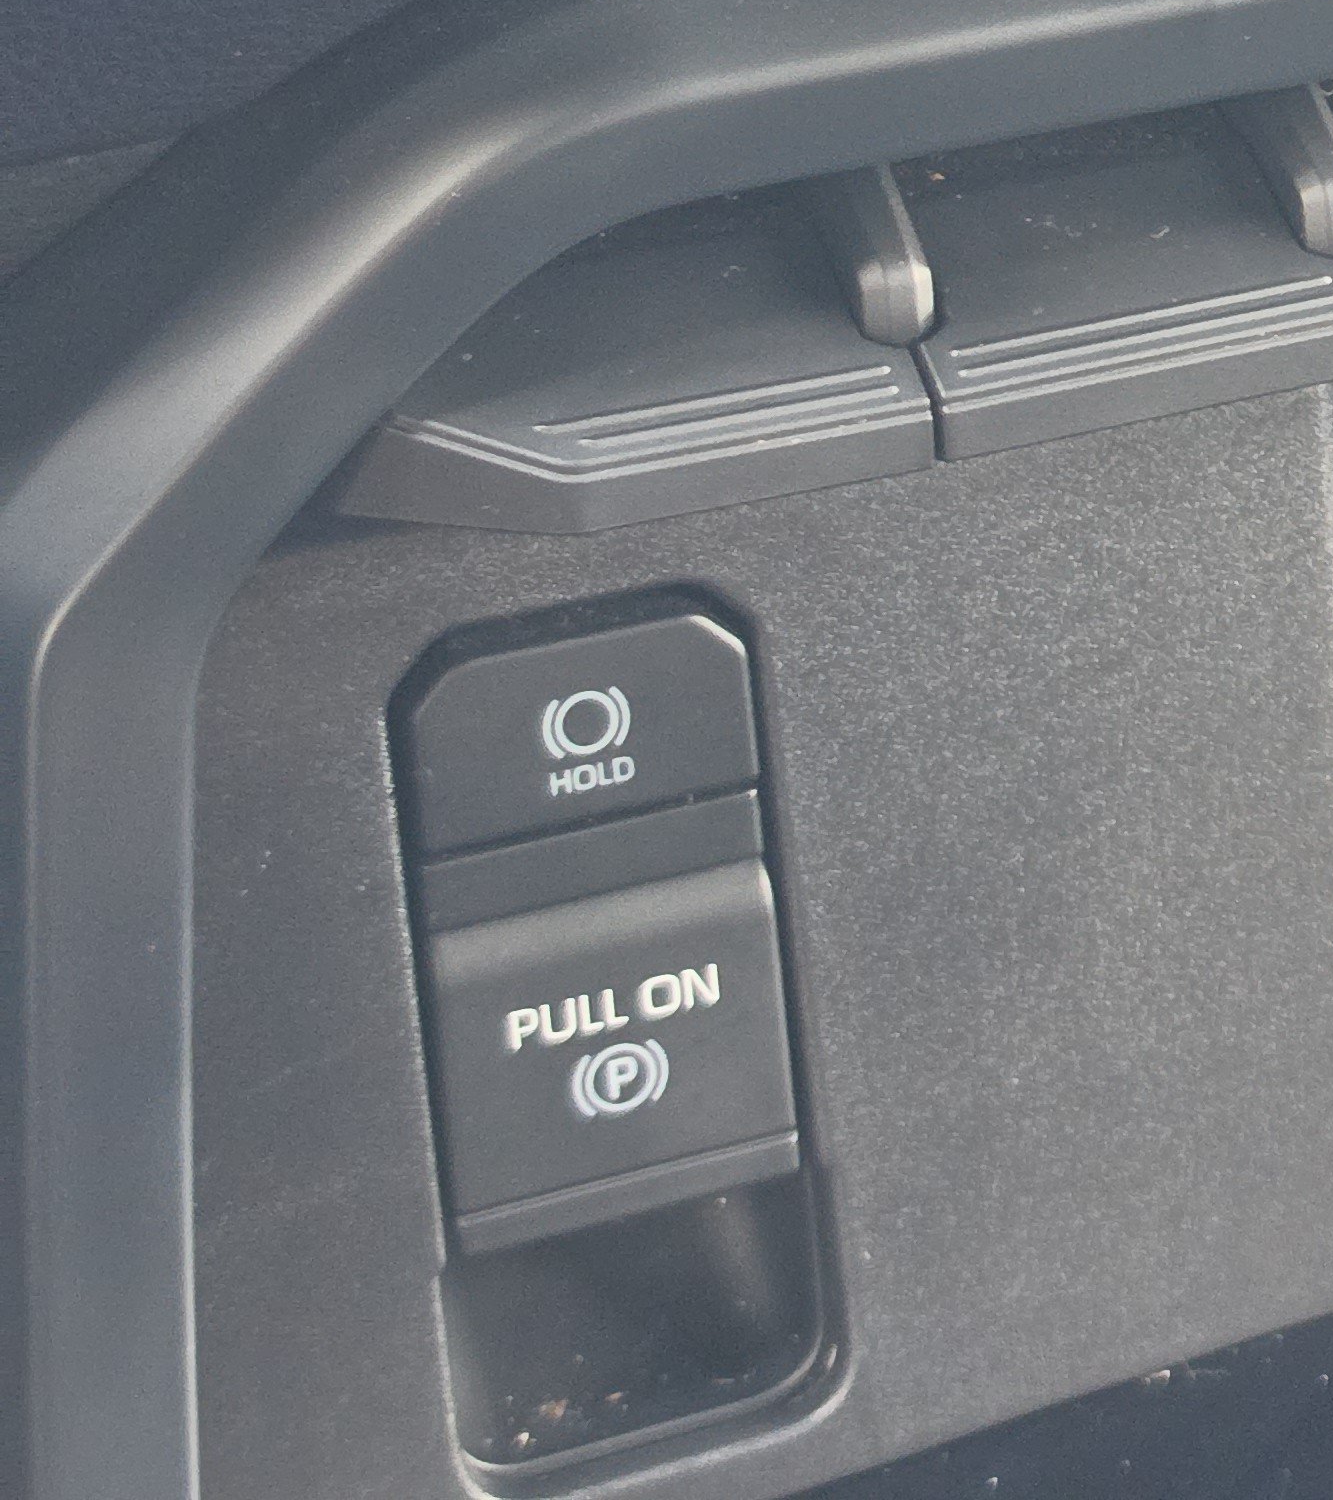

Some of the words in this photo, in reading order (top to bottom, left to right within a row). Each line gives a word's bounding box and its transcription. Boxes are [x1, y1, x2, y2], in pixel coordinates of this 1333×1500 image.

[549, 755, 636, 797] HOLD
[505, 988, 630, 1053] PULL
[636, 963, 721, 1022] ON
[604, 1054, 639, 1100] P
